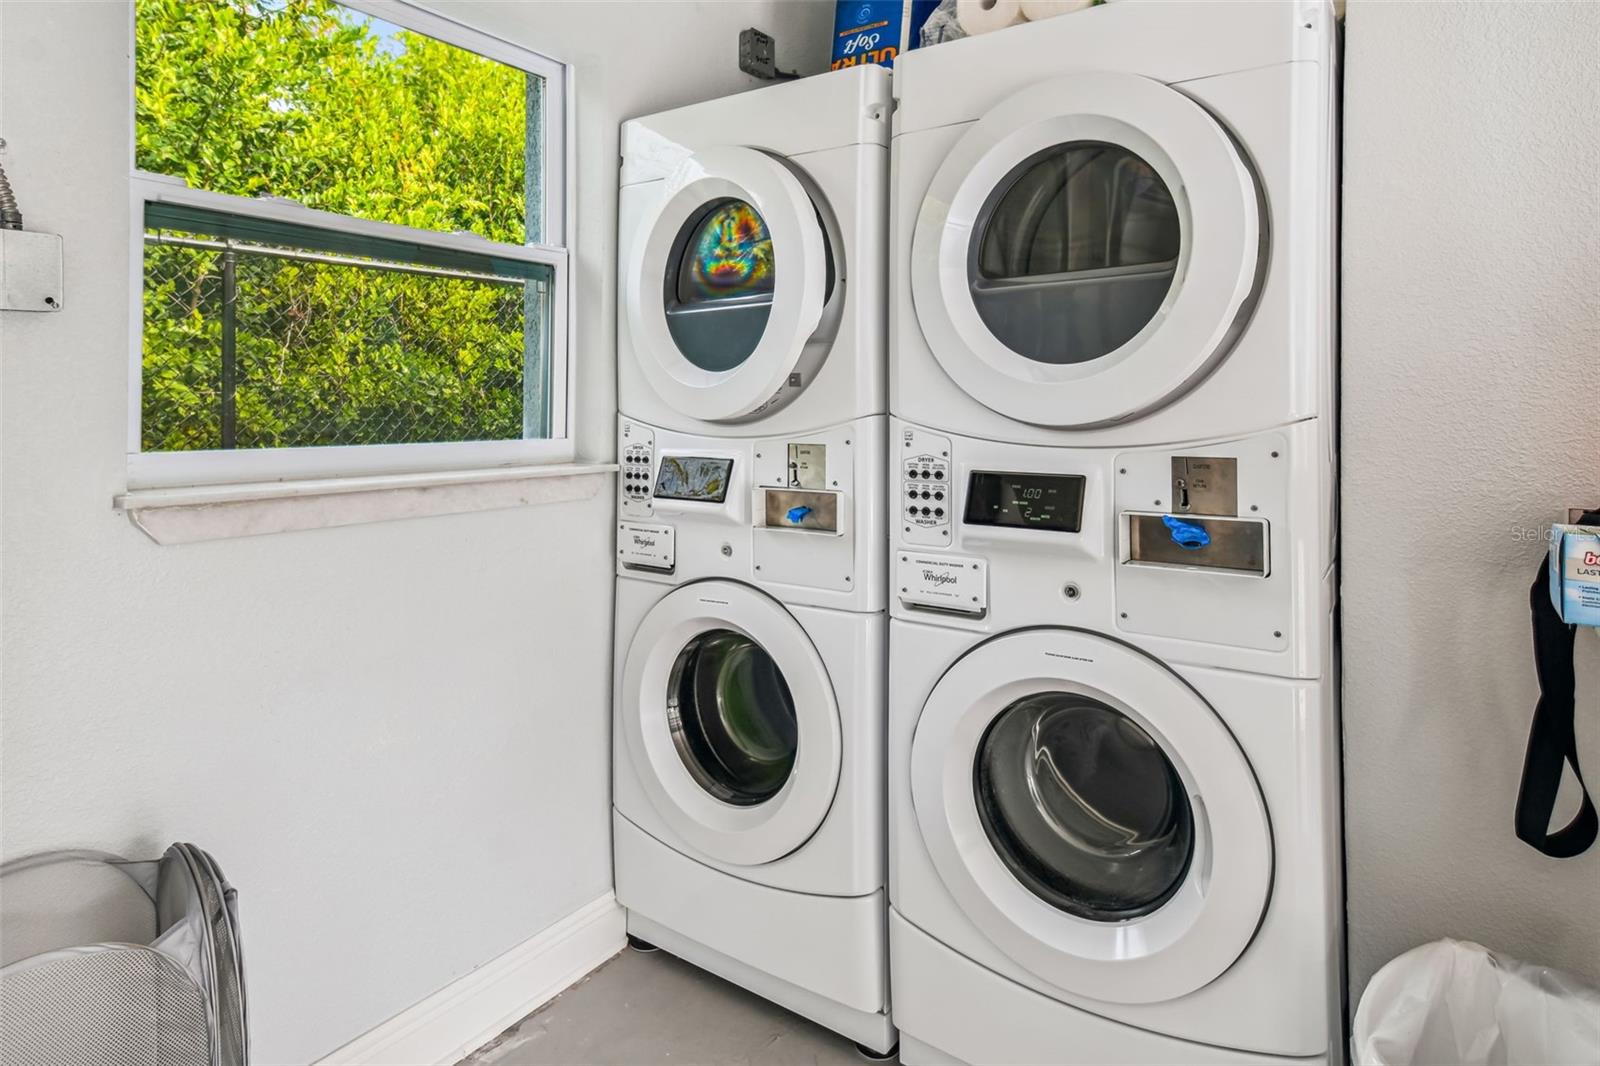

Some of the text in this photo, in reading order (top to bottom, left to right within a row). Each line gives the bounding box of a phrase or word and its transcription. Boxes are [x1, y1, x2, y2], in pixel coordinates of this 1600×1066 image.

[843, 33, 880, 54] Soft
[829, 46, 897, 71] ULTRA
[923, 572, 957, 584] Whirlpool
